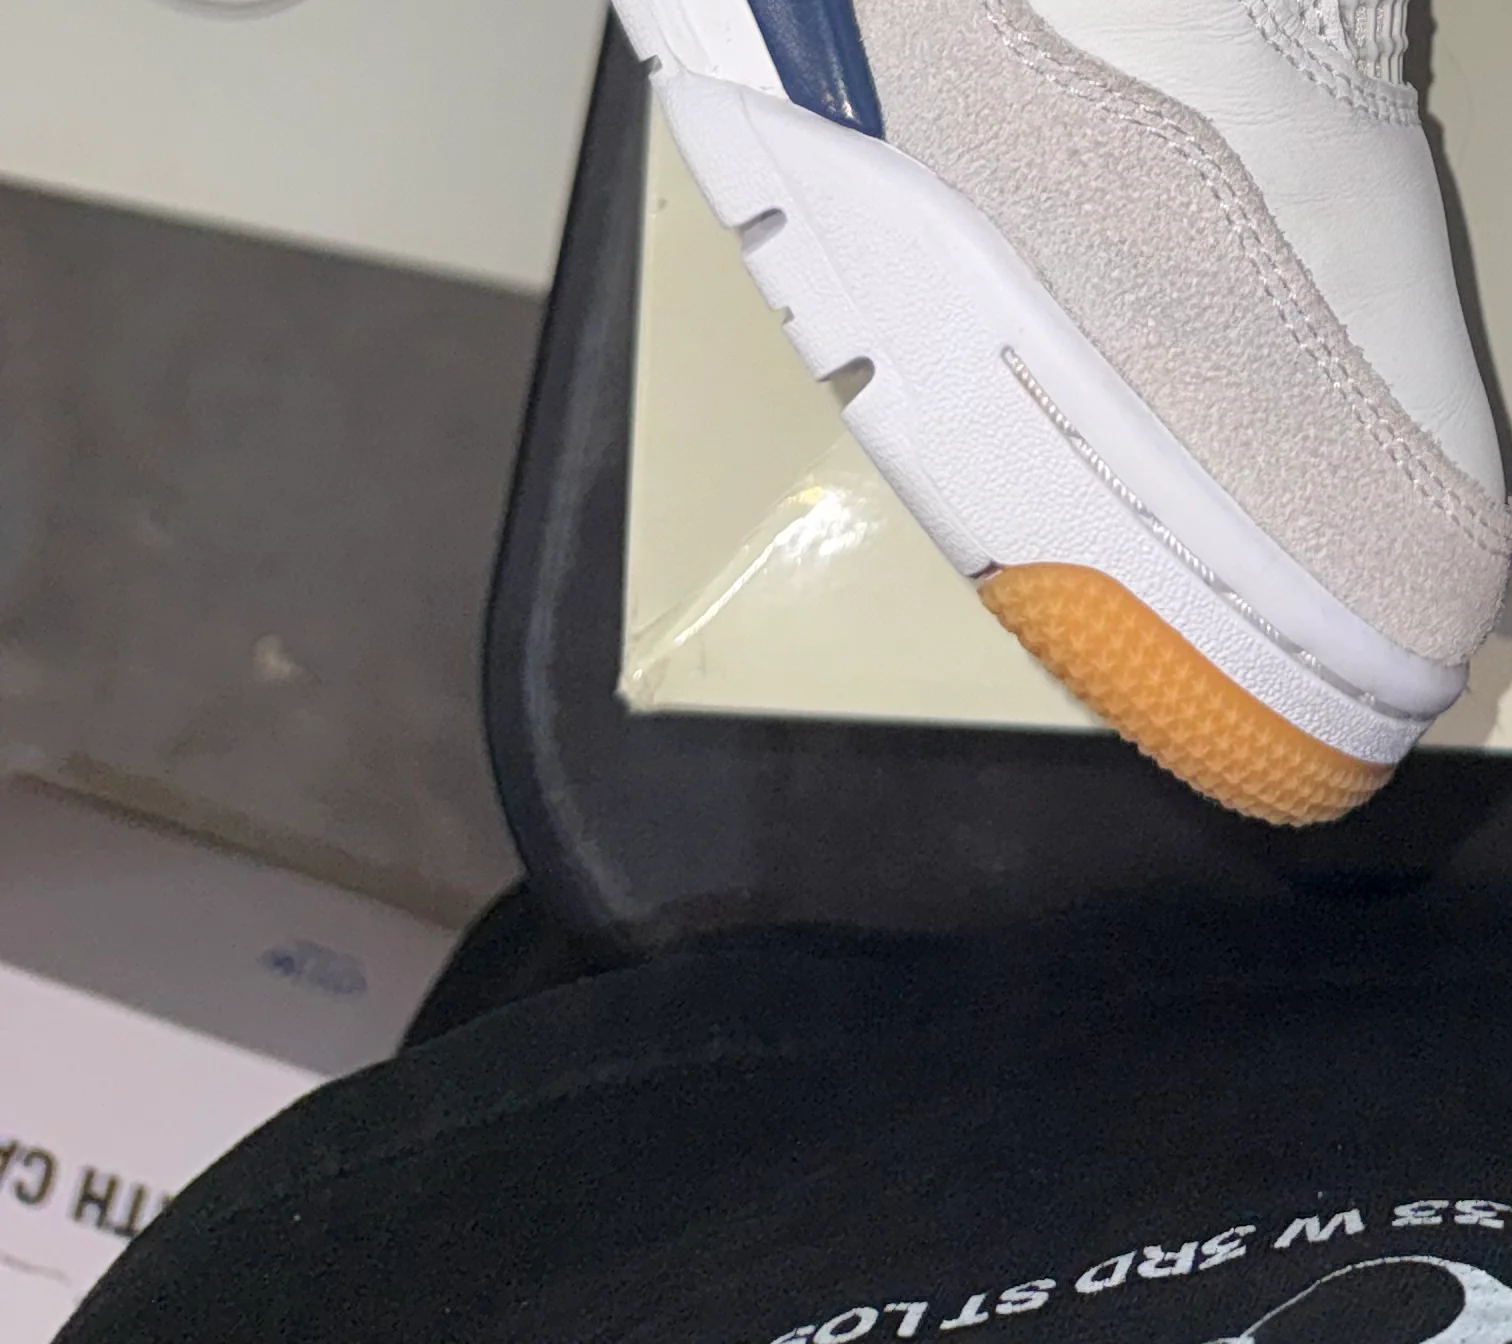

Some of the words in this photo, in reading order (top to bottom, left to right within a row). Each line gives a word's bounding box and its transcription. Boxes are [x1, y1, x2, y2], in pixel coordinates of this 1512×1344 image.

[73, 1166, 174, 1239] TH
[1272, 1208, 1365, 1249] W
[1075, 1225, 1256, 1295] 3RD
[939, 1277, 1057, 1331] ST
